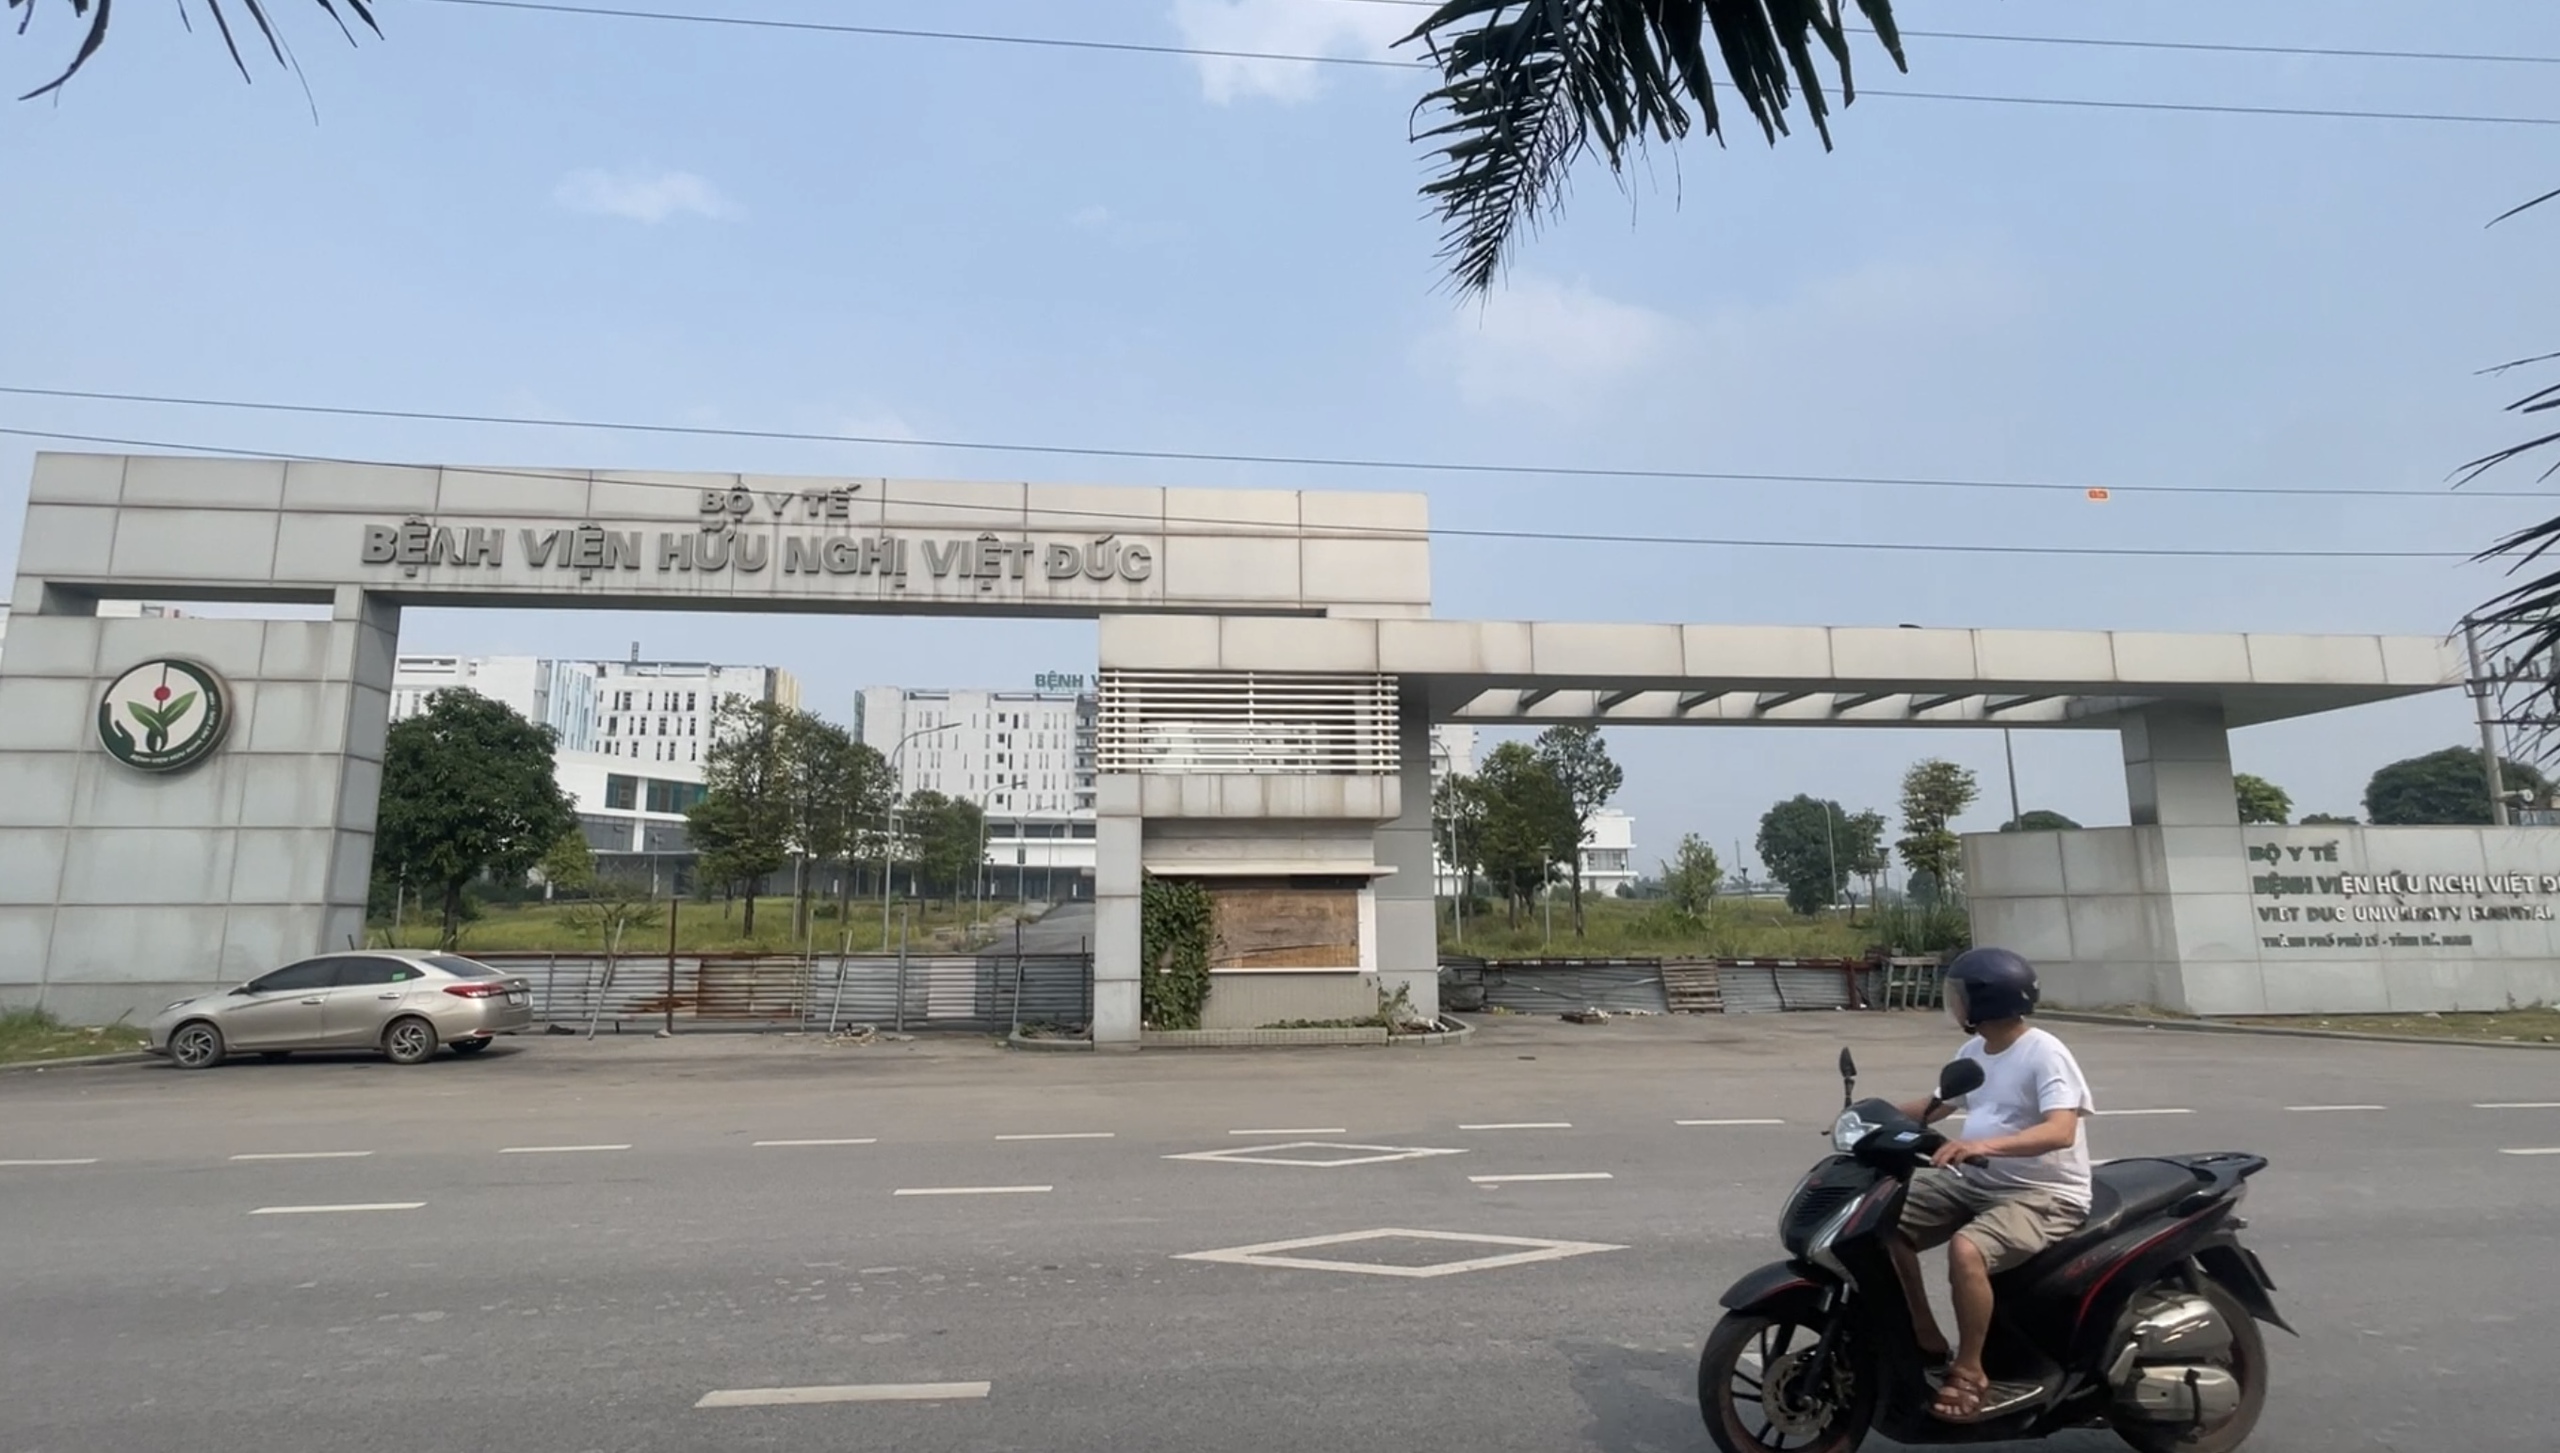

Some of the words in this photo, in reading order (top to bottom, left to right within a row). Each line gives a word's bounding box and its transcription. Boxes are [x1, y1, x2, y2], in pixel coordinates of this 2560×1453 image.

[700, 483, 754, 524] BỘ
[763, 492, 795, 516] Y
[803, 484, 861, 518] TẾ
[361, 513, 505, 578] BỆNH
[519, 520, 643, 581] VIỆN
[657, 520, 768, 573] HỮU
[785, 536, 907, 588] NGHỊ
[921, 531, 1034, 591] VIỆT
[1045, 533, 1152, 582] ĐỨC
[1034, 670, 1083, 691] BỆNH
[2248, 842, 2281, 866] BỘ
[2285, 846, 2303, 861] Y
[2308, 840, 2339, 862] TẾ
[2316, 870, 2370, 899] VIỆN
[2426, 875, 2483, 899] NGHỊ
[2486, 870, 2535, 899] VIỆT
